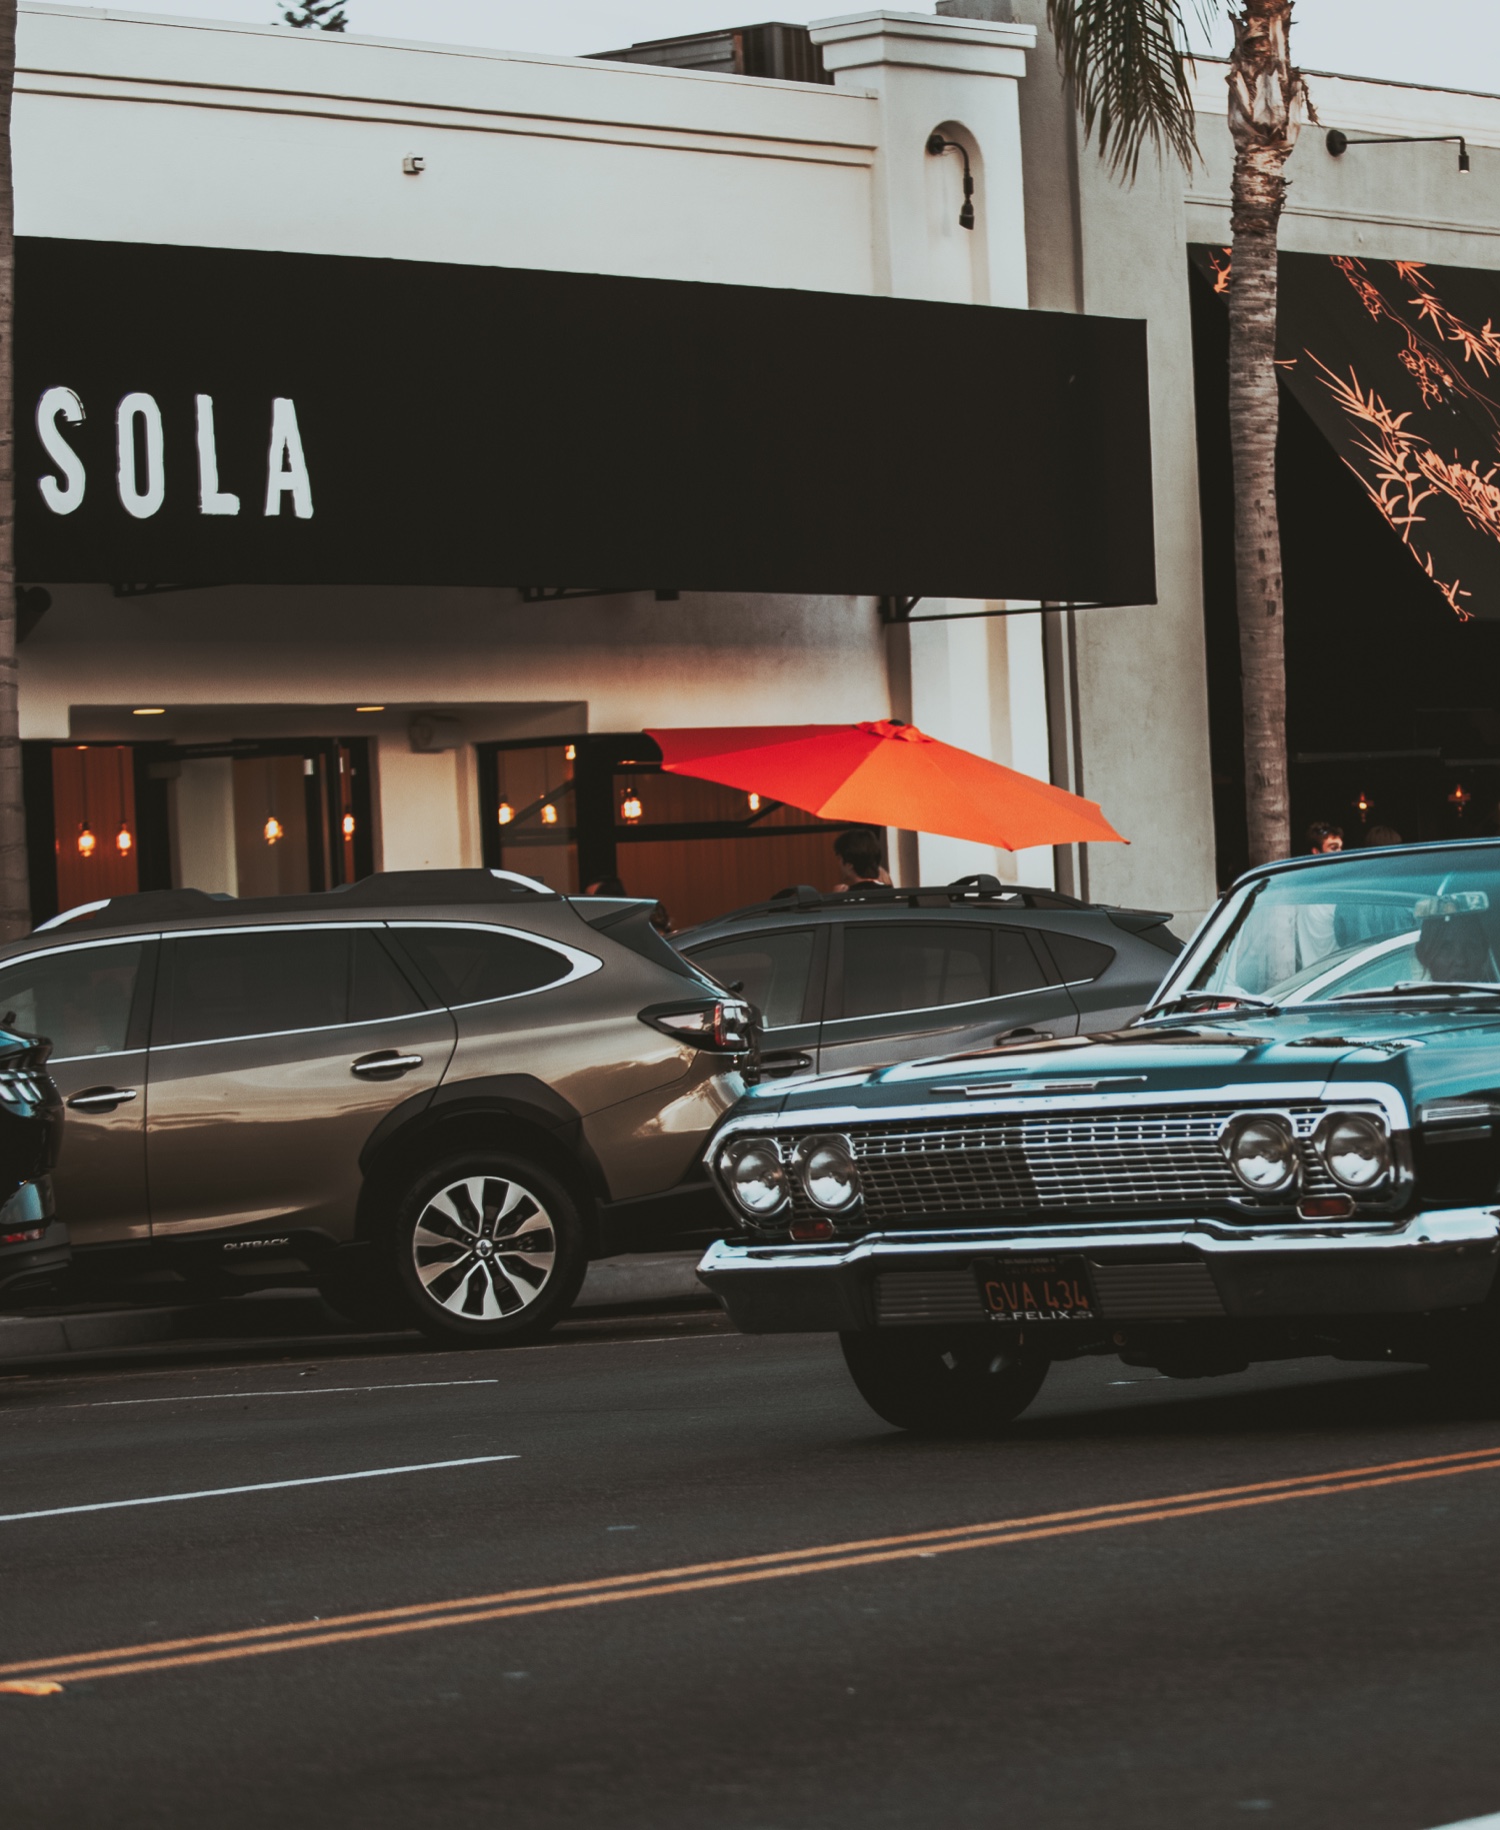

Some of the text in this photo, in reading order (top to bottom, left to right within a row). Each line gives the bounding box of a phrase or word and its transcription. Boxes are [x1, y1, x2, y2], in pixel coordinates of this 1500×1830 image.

[35, 386, 314, 519] SOLA
[223, 1238, 290, 1250] OUTBACK
[985, 1279, 1090, 1311] GVA 434
[1011, 1310, 1071, 1320] FELIX
